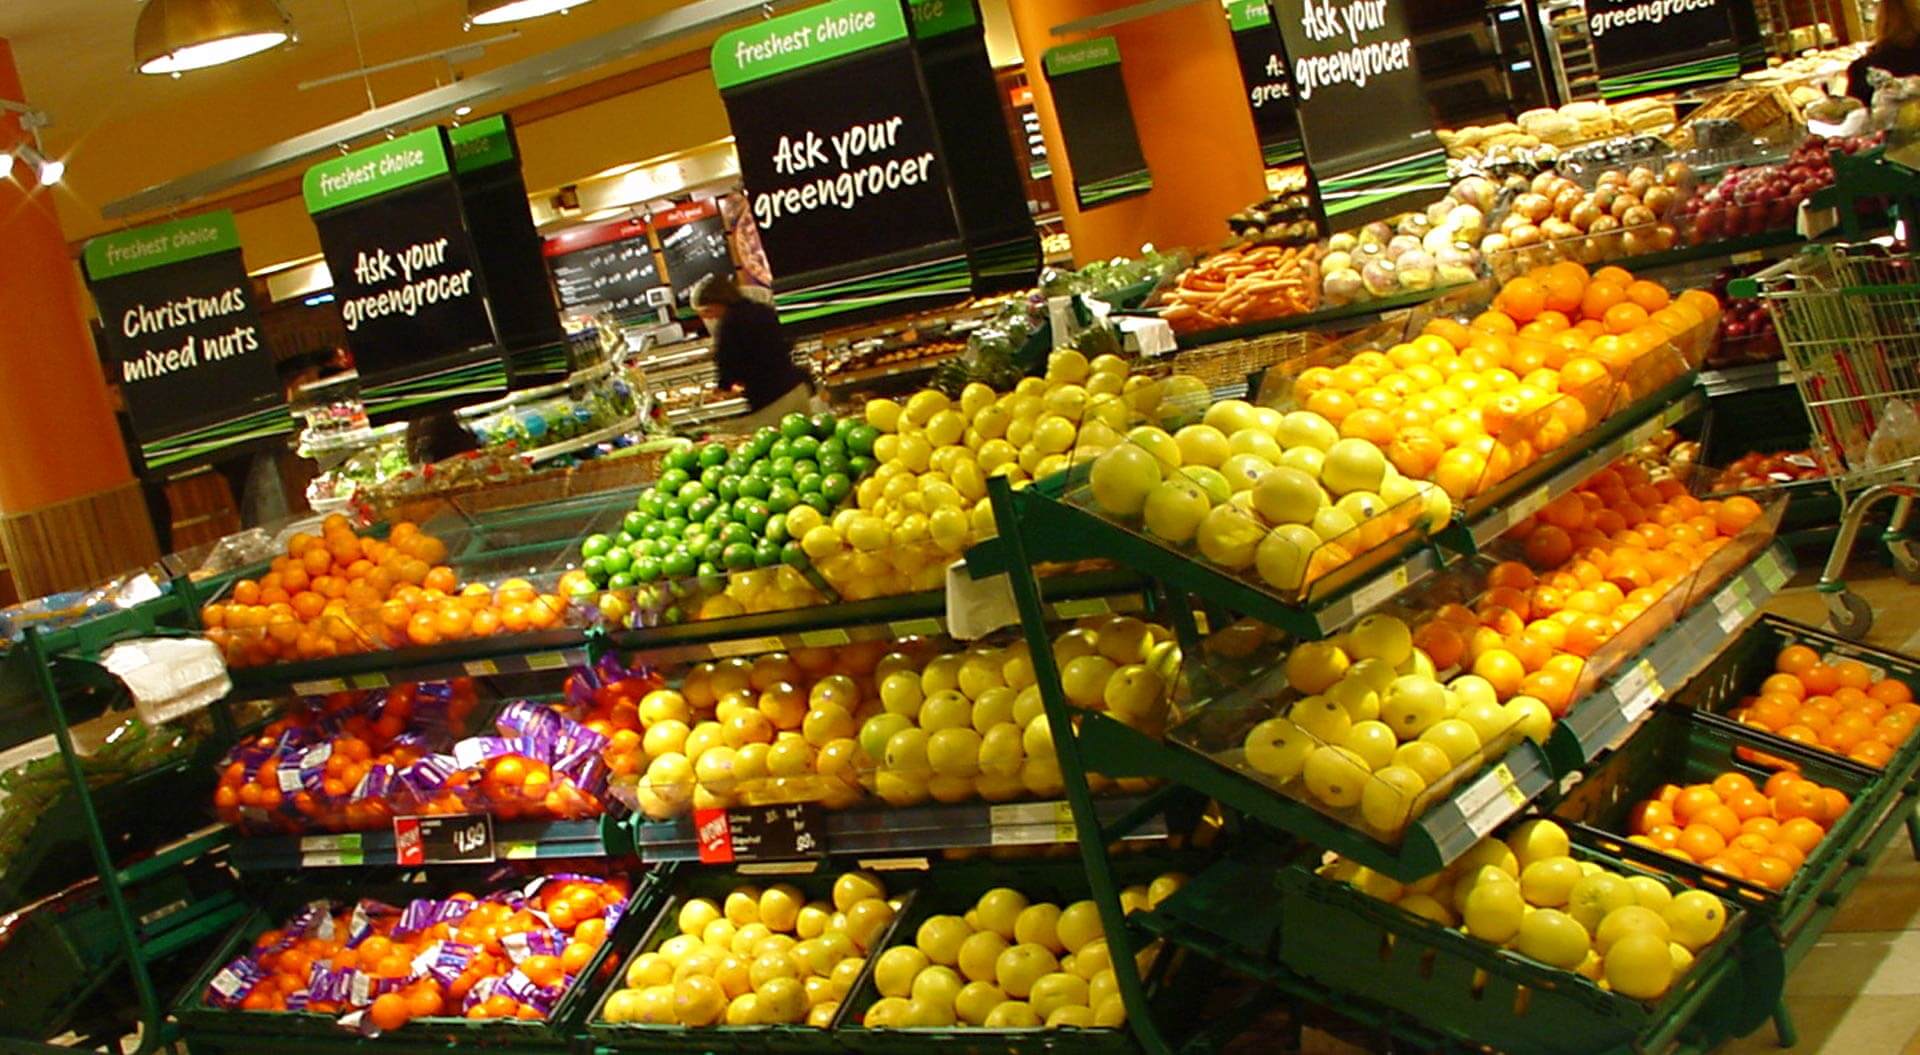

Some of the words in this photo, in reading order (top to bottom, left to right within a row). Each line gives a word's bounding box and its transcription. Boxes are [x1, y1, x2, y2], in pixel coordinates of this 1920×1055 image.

[735, 26, 812, 69] freshest
[816, 10, 876, 43] choice
[1301, 0, 1344, 41] Ask
[1341, 0, 1387, 43] your
[1296, 38, 1411, 100] greengrocer
[320, 162, 376, 196] freshest
[379, 148, 424, 175] choice
[773, 131, 828, 175] Ask
[831, 116, 902, 169] your
[754, 152, 934, 229] greengrocer
[106, 236, 169, 265] freshest
[172, 227, 218, 248] choice
[355, 248, 396, 285] Ask
[397, 238, 448, 282] your
[122, 287, 246, 338] Christmas
[342, 269, 473, 330] greengrocer
[122, 336, 198, 382] mixed
[202, 326, 259, 361] nuts
